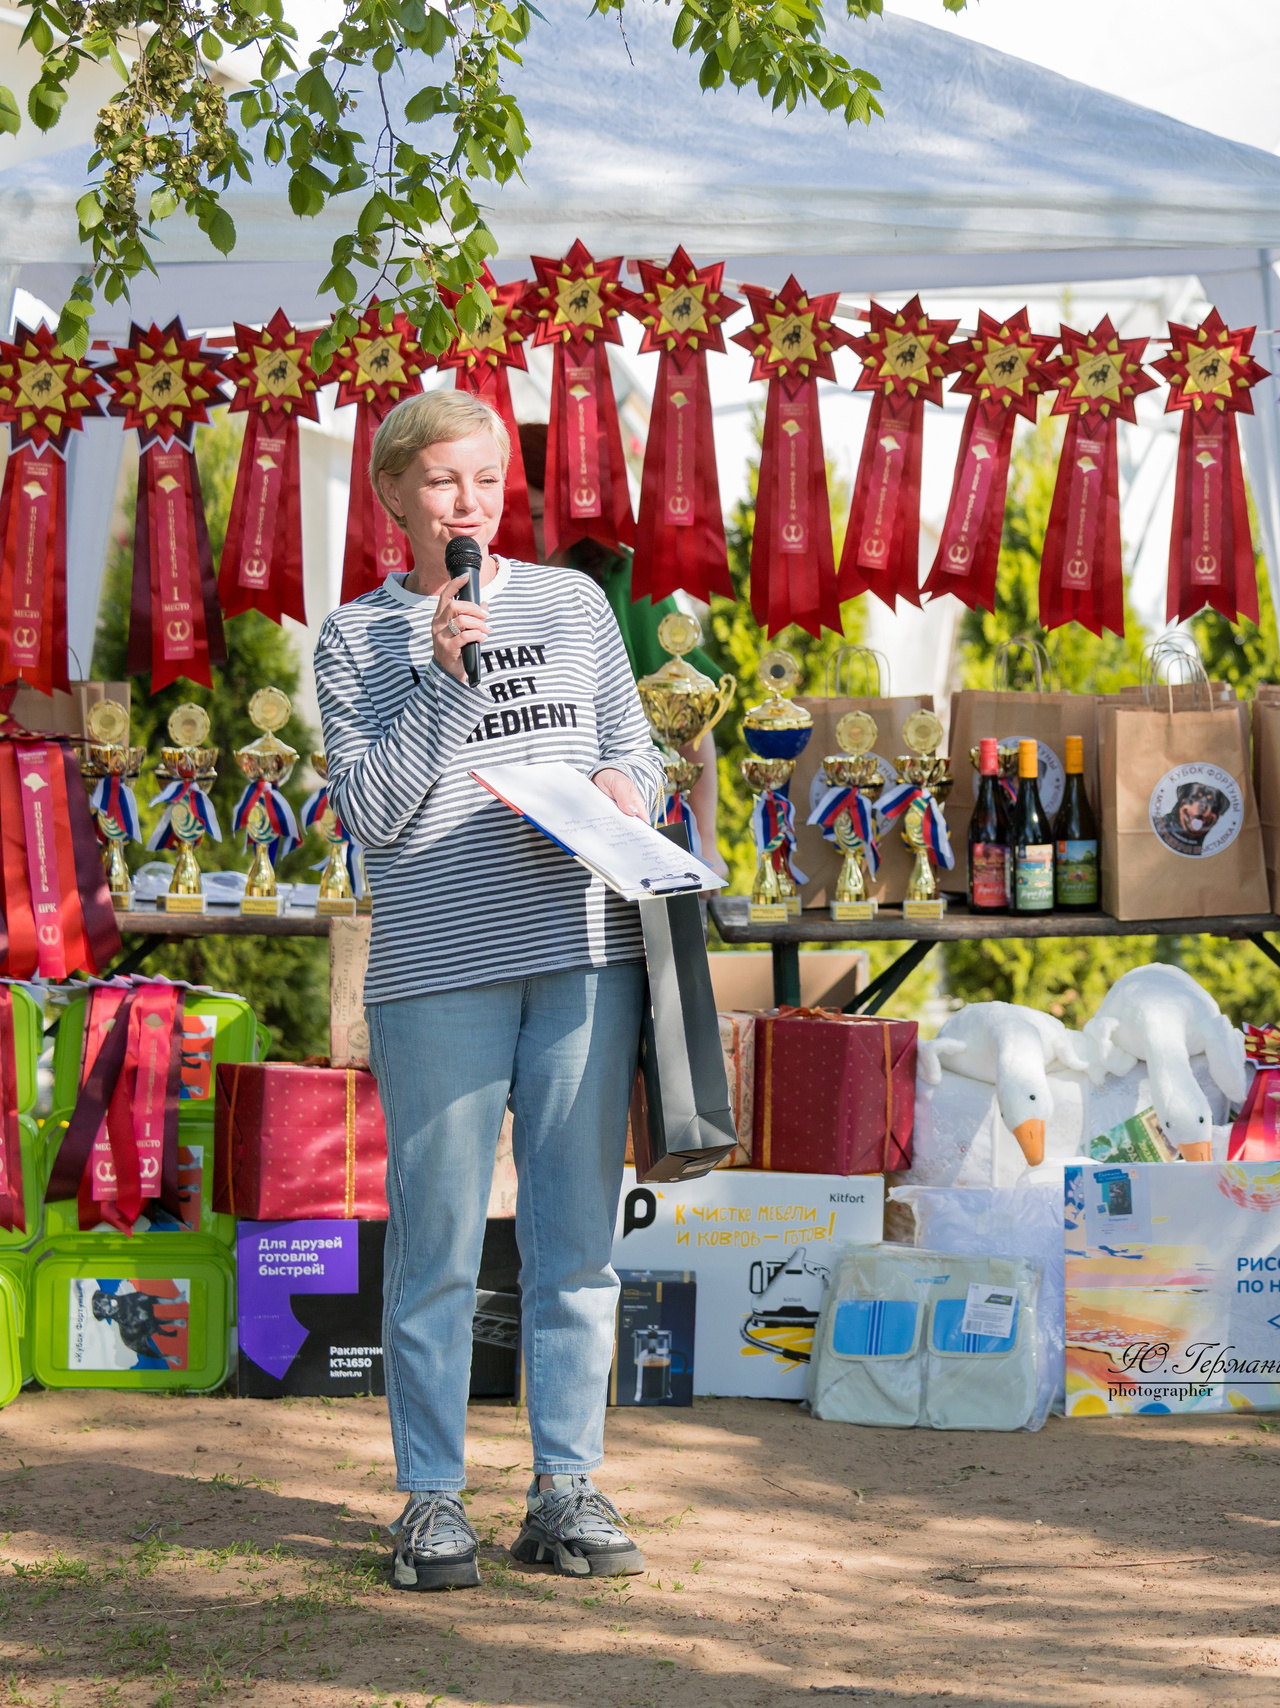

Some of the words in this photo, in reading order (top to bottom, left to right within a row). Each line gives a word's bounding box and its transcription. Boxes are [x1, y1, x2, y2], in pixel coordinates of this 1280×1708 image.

[163, 602, 190, 612] МЕСТО
[13, 609, 40, 619] МЕСТО
[481, 644, 547, 674] THAT
[489, 676, 538, 703] RET
[1168, 766, 1204, 783] КУБОК
[1206, 769, 1241, 813] ФОРТУНЫ
[829, 1193, 865, 1203] Kitfort
[258, 1238, 287, 1251] Для
[290, 1236, 343, 1252] друзей
[258, 1252, 320, 1264] готовлю
[258, 1264, 326, 1279] быстрей!
[1236, 1280, 1264, 1294] ПО
[330, 1346, 384, 1357] Раклетни
[330, 1358, 373, 1369] КТ-1650
[330, 1370, 363, 1379] kitfort.ru
